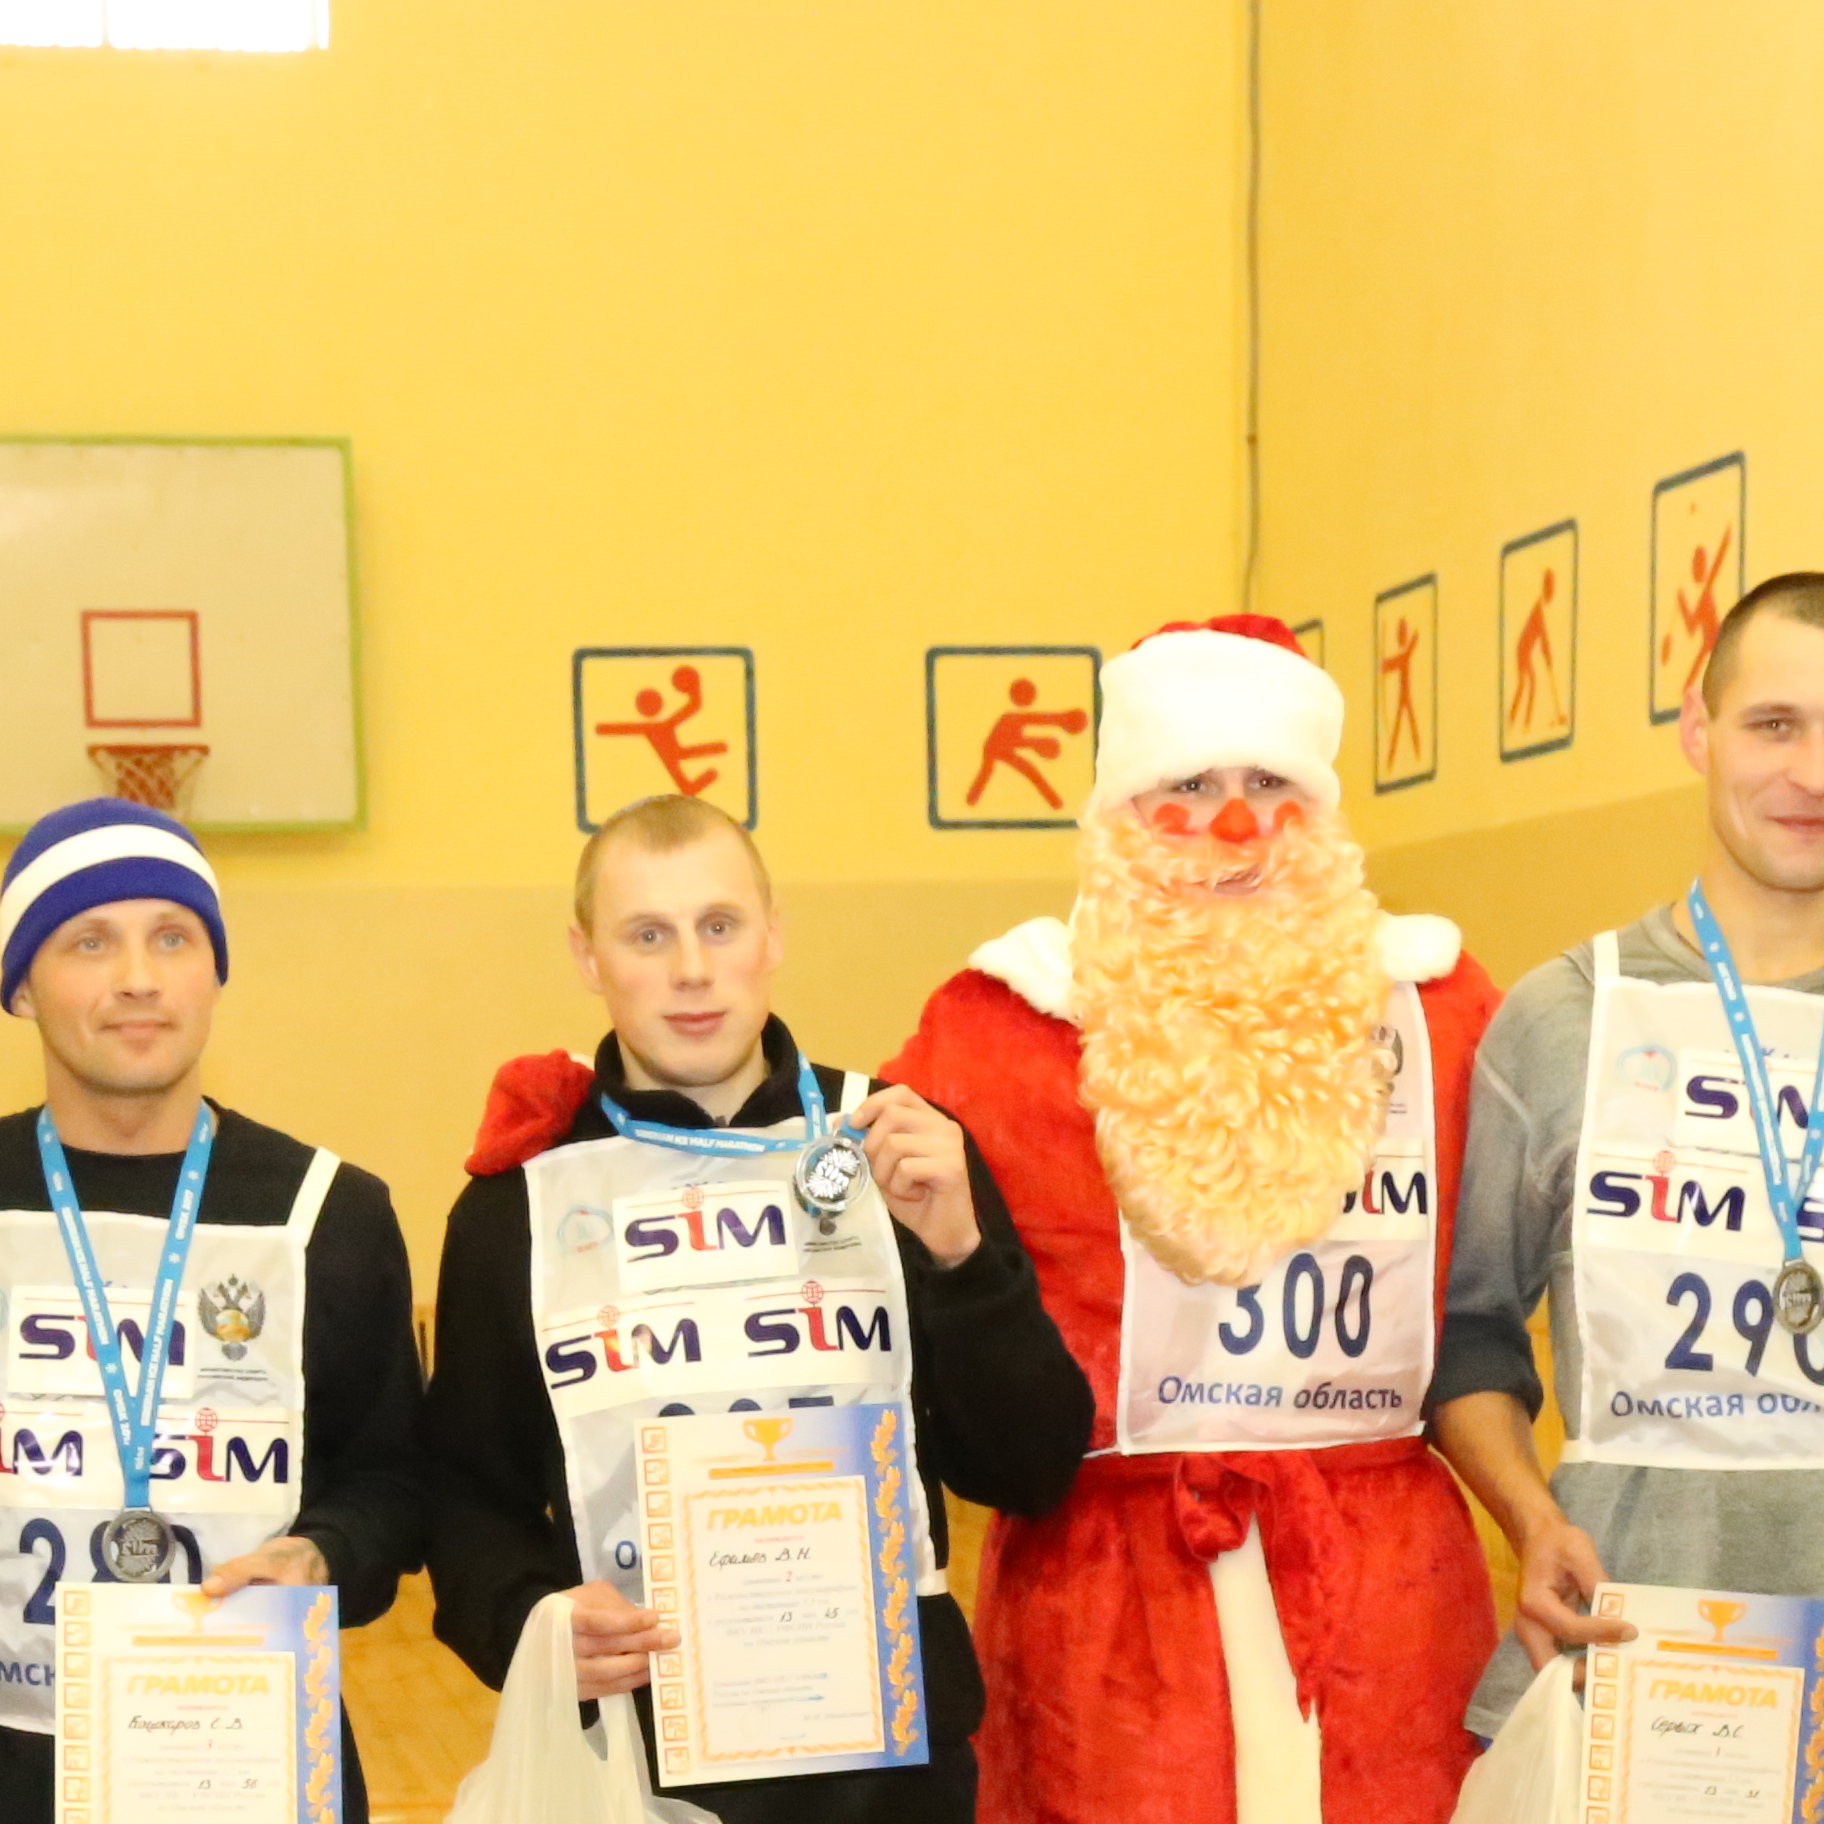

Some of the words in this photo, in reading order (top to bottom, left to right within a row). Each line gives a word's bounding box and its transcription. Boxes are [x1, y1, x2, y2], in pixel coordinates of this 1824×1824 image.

[1342, 1170, 1428, 1215] iM
[1218, 1252, 1375, 1359] 300
[1158, 1375, 1283, 1410] Омская
[1293, 1381, 1404, 1411] область
[1610, 1391, 1745, 1419] Омская
[707, 1501, 843, 1531] ГРАМОТА
[125, 1674, 270, 1696] ГРАМОТА
[1648, 1679, 1778, 1709] ГРАМОТА
